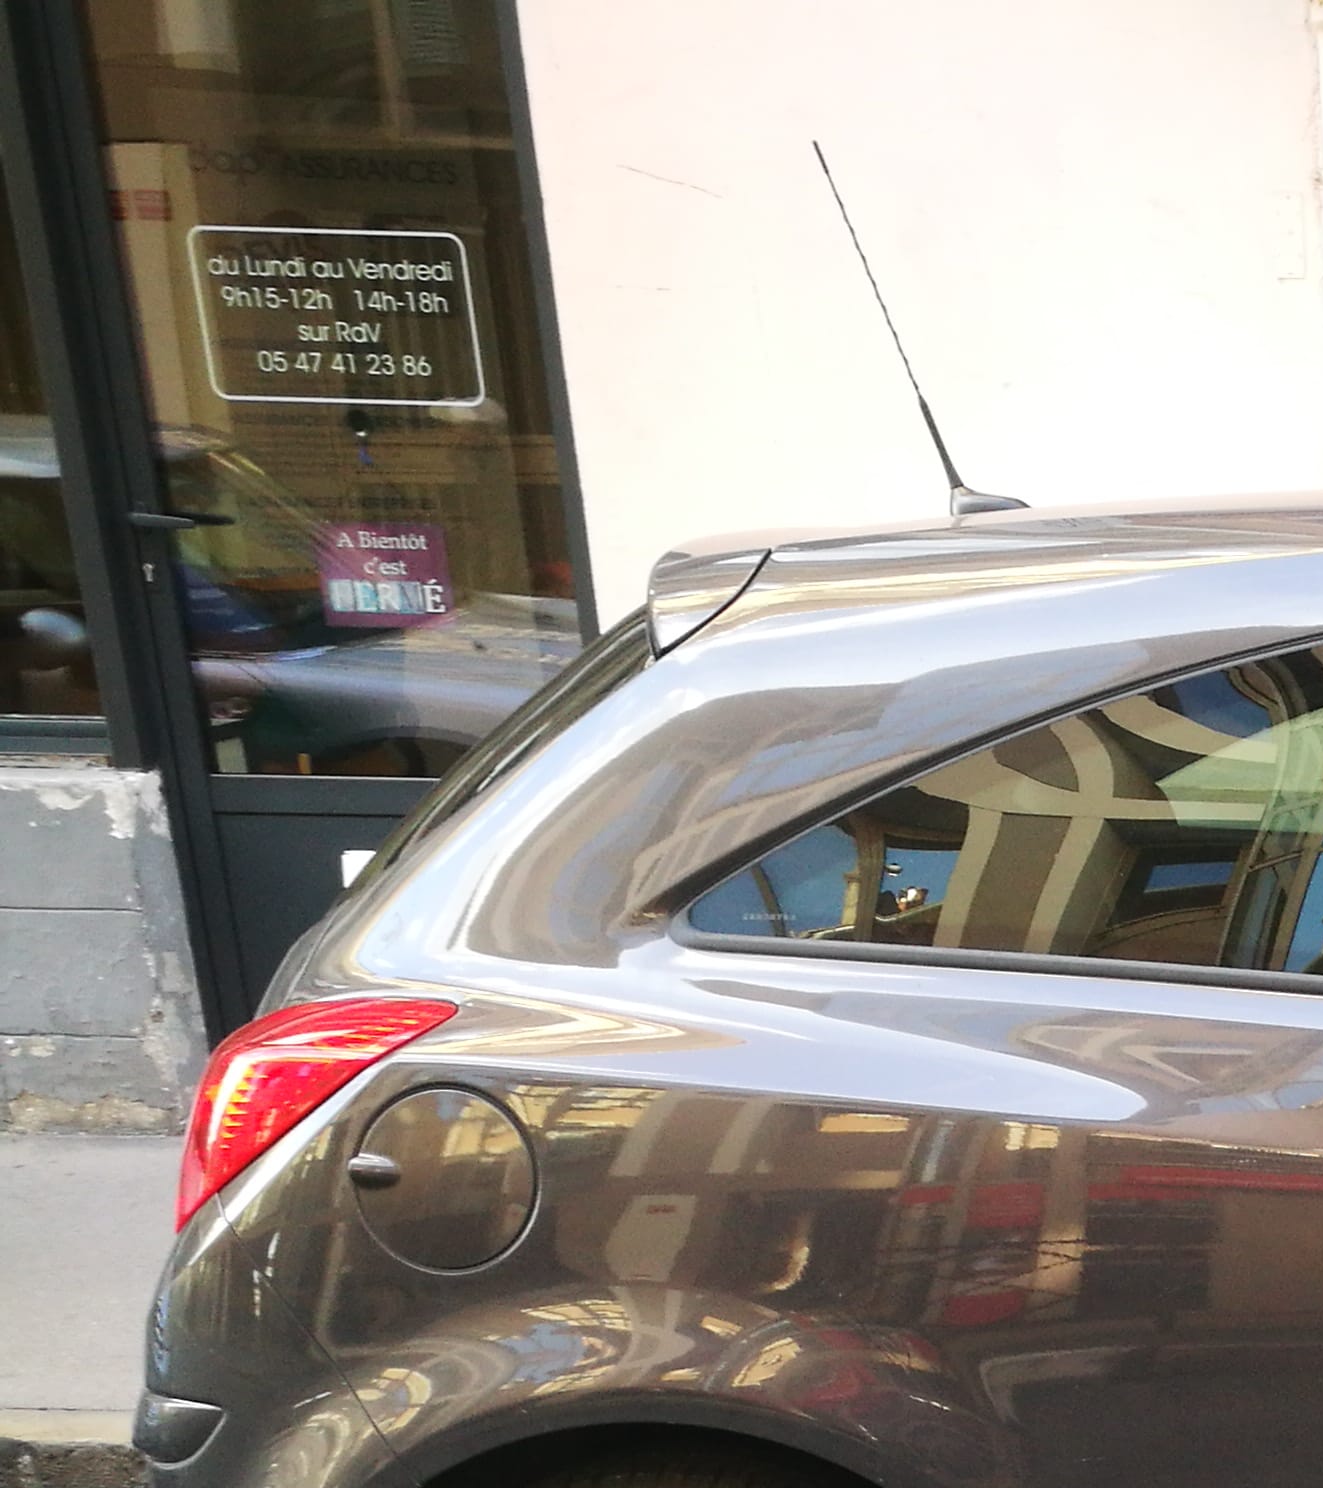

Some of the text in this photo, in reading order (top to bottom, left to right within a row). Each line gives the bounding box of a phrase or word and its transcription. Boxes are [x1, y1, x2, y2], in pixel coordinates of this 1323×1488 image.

[207, 254, 454, 282] du Lundi au Vendredi
[220, 285, 449, 314] 9h15-12h 14h-18h
[297, 320, 382, 344] sur RdV
[257, 350, 432, 377] 05 47 41 23 86
[336, 530, 429, 551] A Bientôt
[363, 556, 409, 576] c'est
